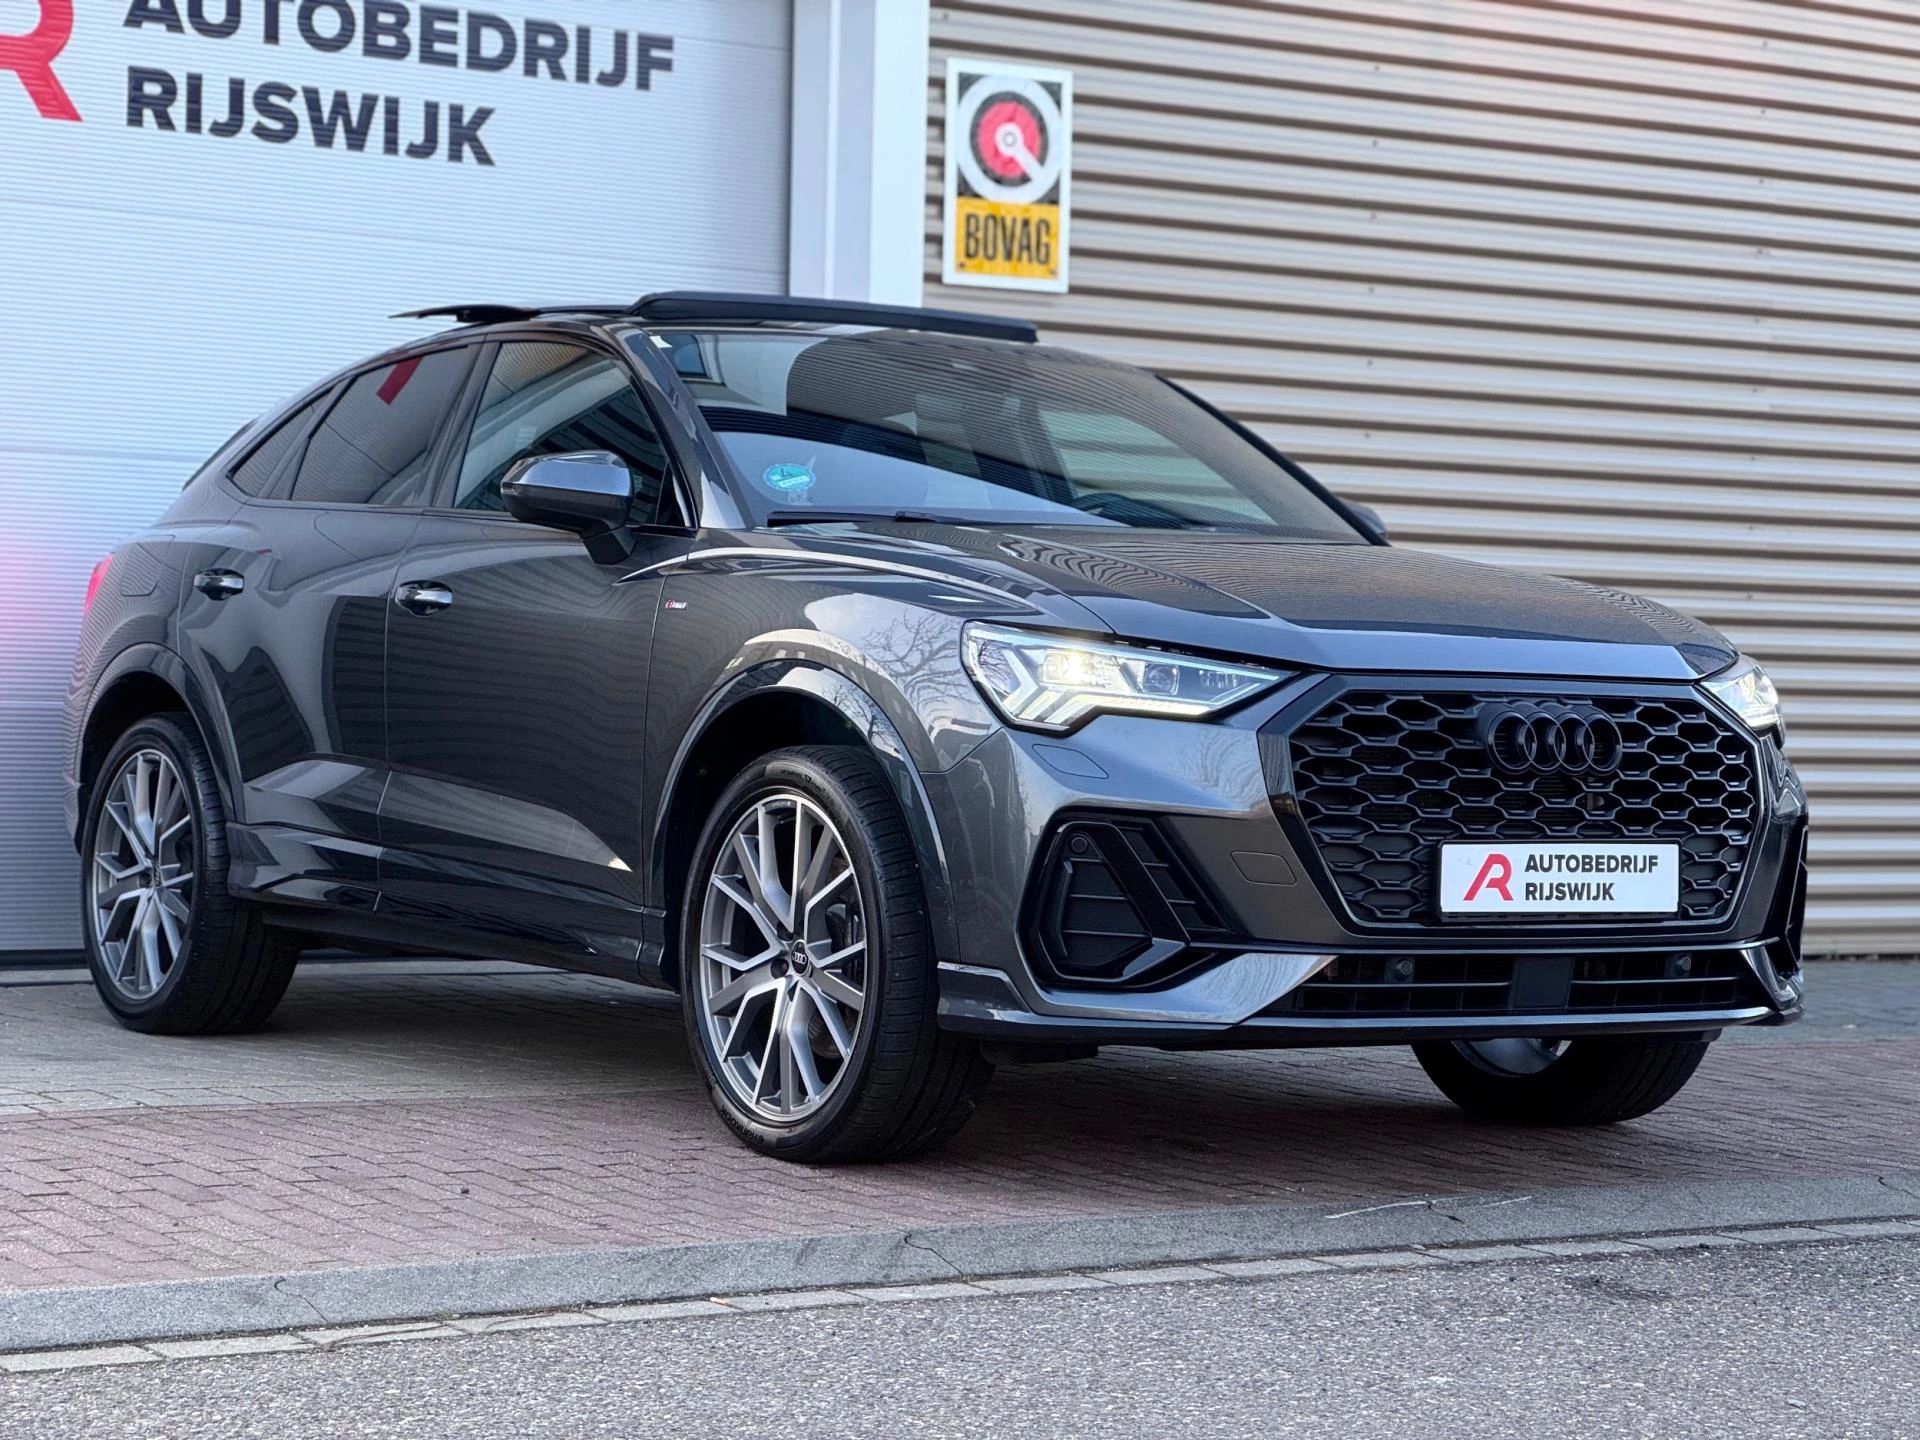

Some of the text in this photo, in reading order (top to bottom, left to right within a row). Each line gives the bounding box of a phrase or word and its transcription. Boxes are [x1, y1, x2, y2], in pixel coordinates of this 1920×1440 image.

[122, 0, 674, 91] AUTOBEDRIJF
[126, 65, 495, 167] RIJSWIJK
[965, 213, 1050, 265] BOVAG
[1524, 854, 1659, 873] AUTOBEDRIJF
[1525, 882, 1615, 901] RIJSWIJK
